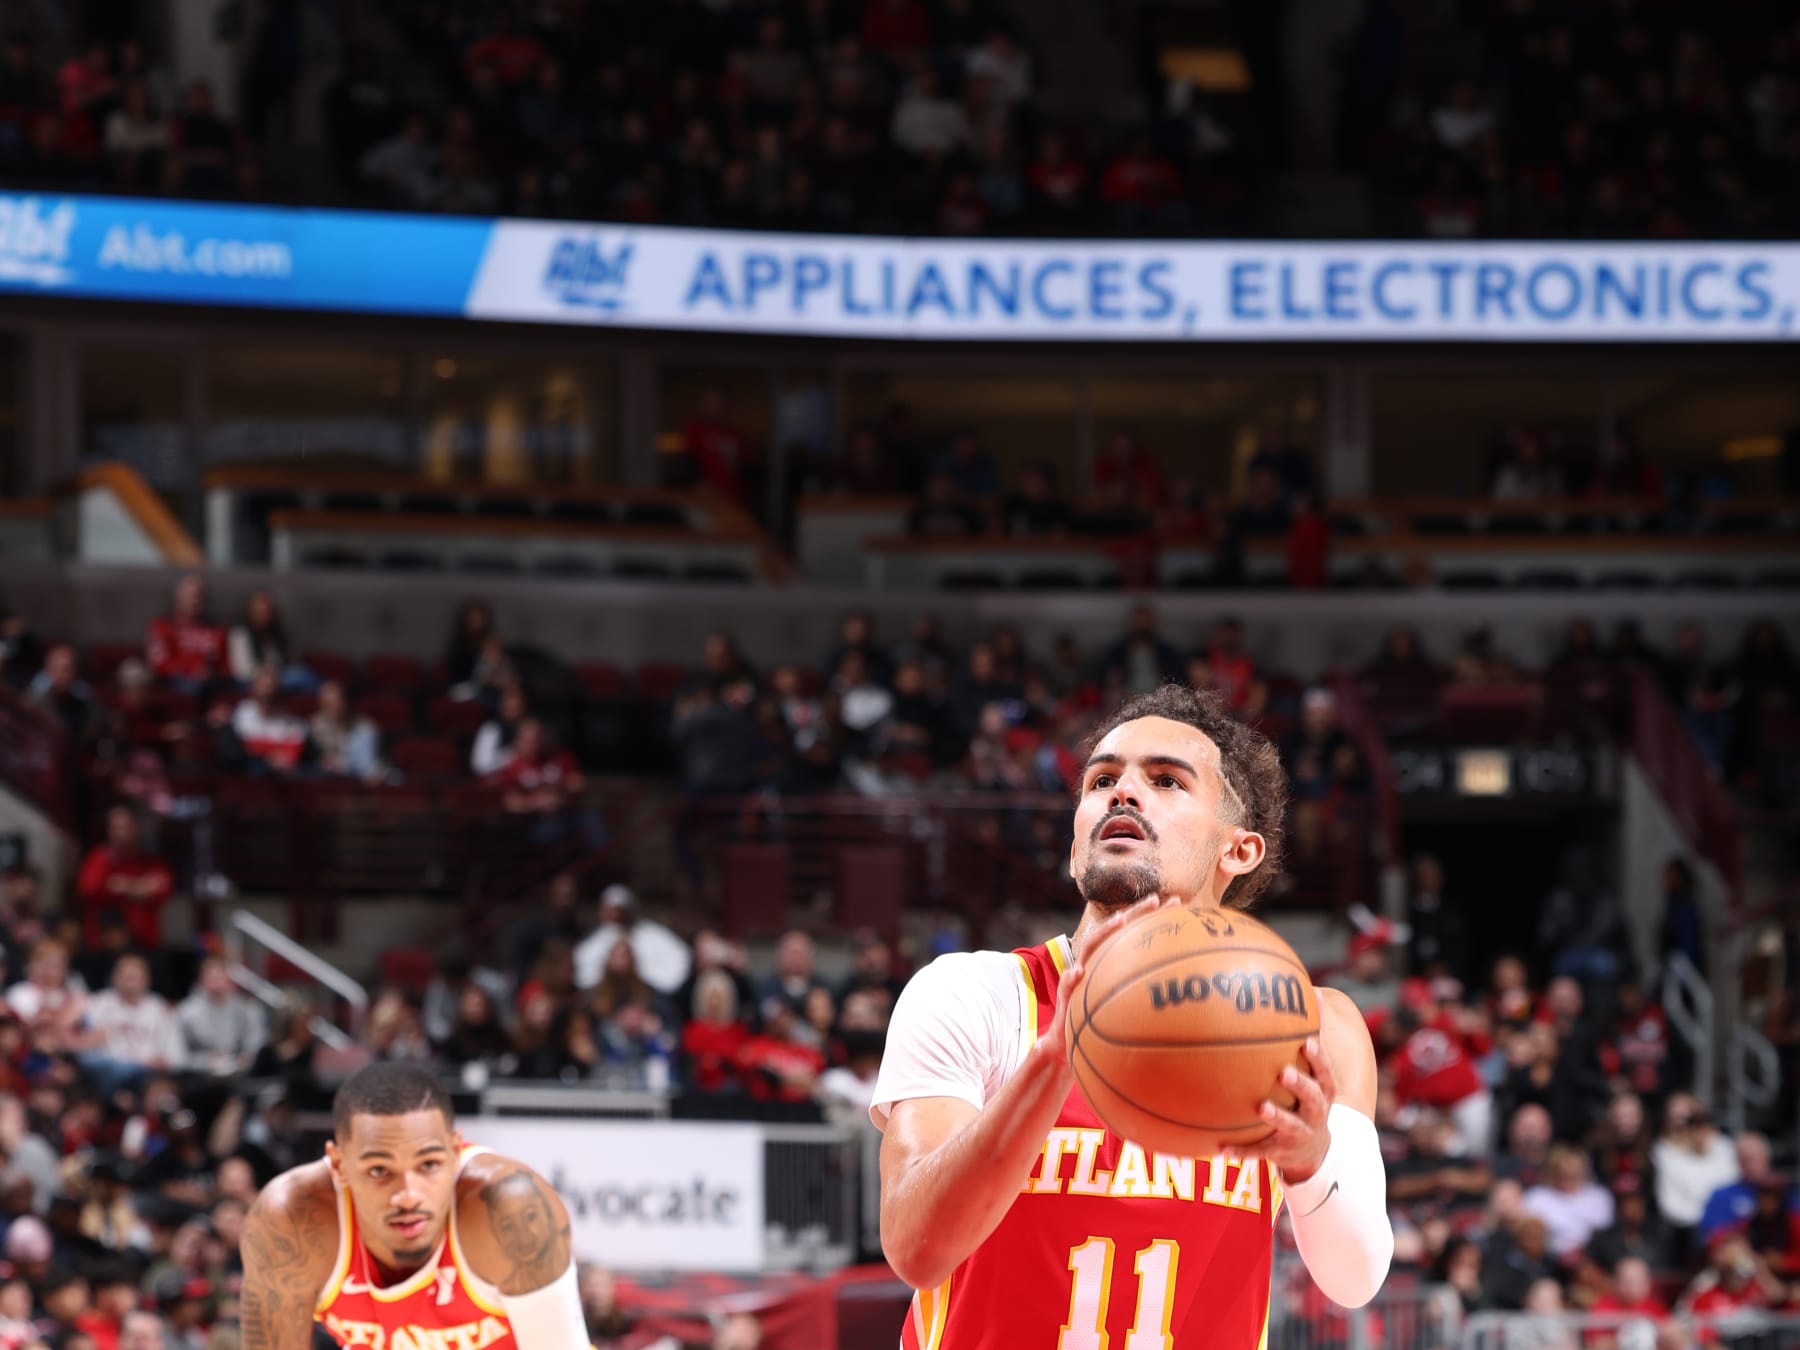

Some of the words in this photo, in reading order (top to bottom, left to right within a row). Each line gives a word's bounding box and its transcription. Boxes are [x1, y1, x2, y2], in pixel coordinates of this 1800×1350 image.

[98, 221, 292, 278] Abt.com
[684, 250, 1199, 335] APPLIANCES,
[1229, 258, 1796, 334] ELECTRONICS,
[1148, 970, 1308, 1019] Wilson
[552, 1163, 739, 1226] vocate
[1020, 1126, 1262, 1214] TLANTA
